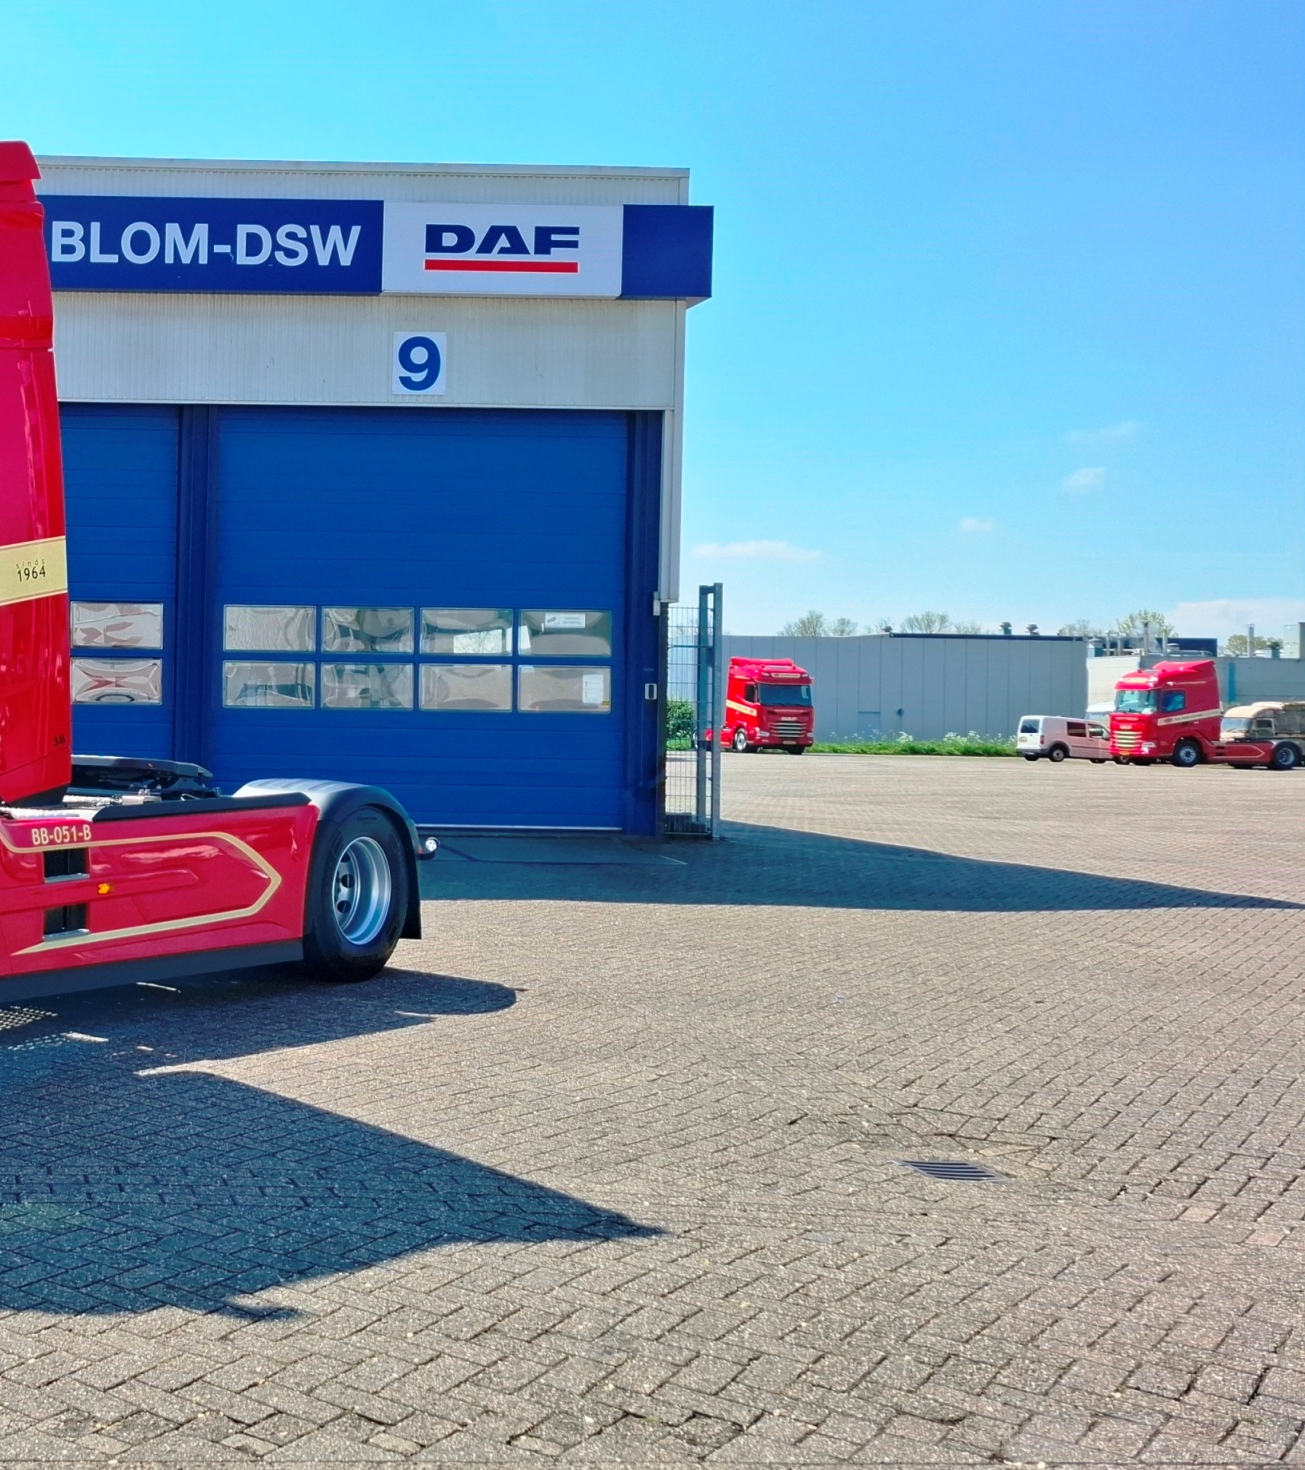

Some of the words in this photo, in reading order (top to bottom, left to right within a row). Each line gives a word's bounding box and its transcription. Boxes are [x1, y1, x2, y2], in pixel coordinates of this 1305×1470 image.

[51, 220, 361, 267] BLOM-DSW
[425, 223, 579, 255] DAF
[397, 335, 442, 391] 9
[17, 565, 46, 582] 1964
[31, 824, 92, 845] BB-051-B
